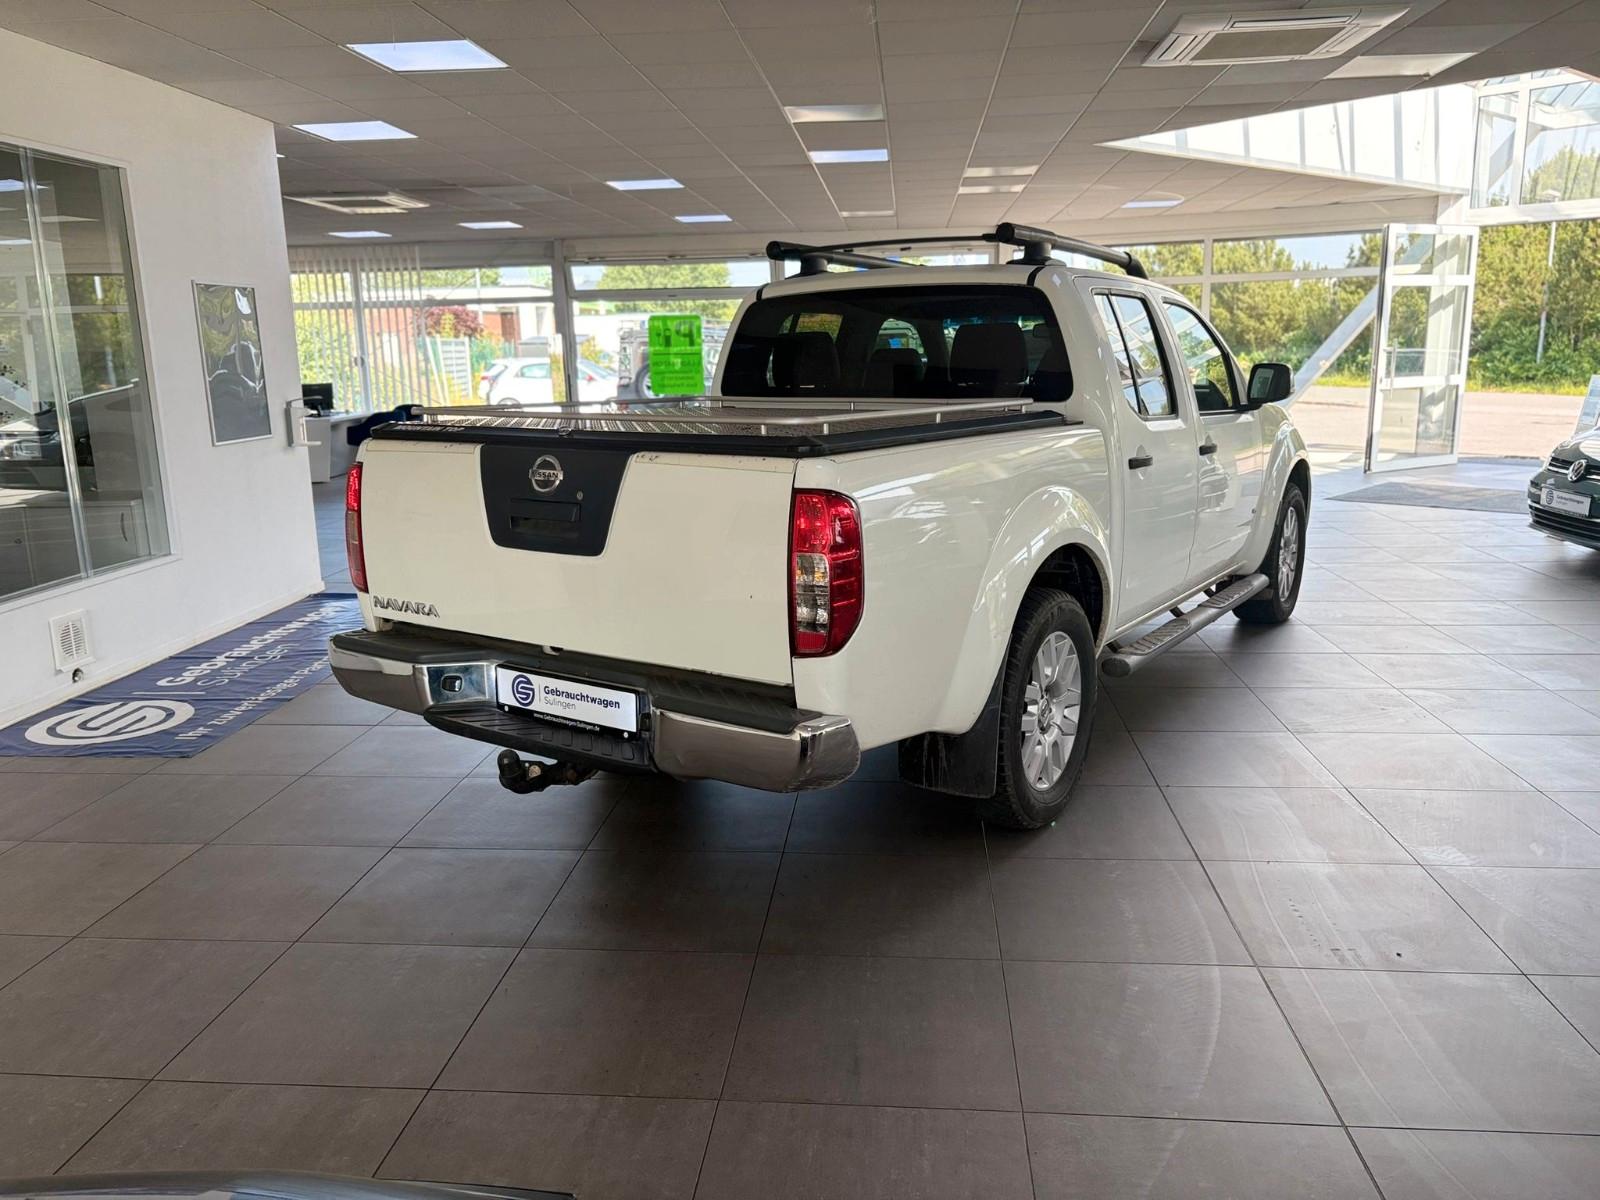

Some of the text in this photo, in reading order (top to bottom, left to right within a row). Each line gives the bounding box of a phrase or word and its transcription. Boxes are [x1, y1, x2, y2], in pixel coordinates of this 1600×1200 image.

[532, 470, 559, 479] NISSAN
[373, 595, 440, 618] NAVARA
[196, 643, 300, 686] Sulingen
[174, 726, 213, 740] Ihr
[207, 675, 305, 725] zuverlässiger
[543, 685, 620, 709] Gebrauchtwagen
[544, 696, 576, 710] Sulingen
